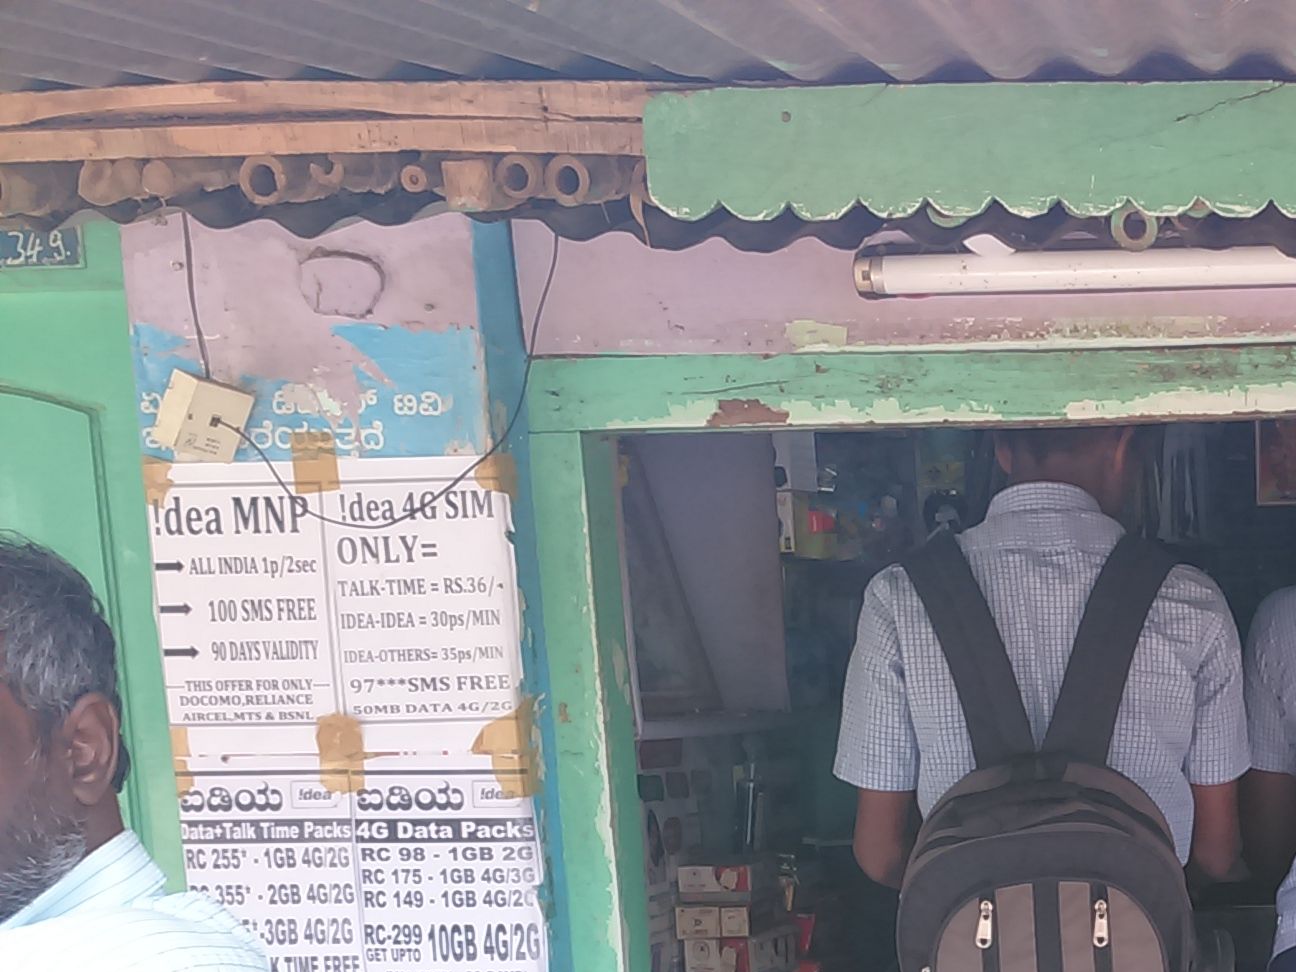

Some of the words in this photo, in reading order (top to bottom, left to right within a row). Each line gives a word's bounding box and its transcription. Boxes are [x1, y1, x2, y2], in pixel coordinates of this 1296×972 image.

[402, 491, 437, 520] 4G
[445, 490, 494, 519] SIM
[231, 495, 309, 535] MNP
[189, 558, 216, 575] ALL
[218, 557, 259, 575] INDIA
[262, 555, 317, 578] 1p/2sec
[338, 578, 426, 597] TALK-TIME
[208, 599, 237, 622] 100
[241, 599, 273, 622] SMS
[277, 599, 317, 621] FREE
[341, 612, 415, 630] IDEA-IDEA
[431, 609, 501, 631] 30ps/MIN
[212, 642, 226, 661] 90
[230, 641, 262, 661] DAYS
[262, 640, 319, 660] VALIDITY
[441, 646, 504, 664] 35ps/MIN
[185, 680, 213, 692] THIS
[215, 680, 253, 692] OFFER
[257, 680, 279, 691] FOR
[282, 679, 313, 691] ONLY
[456, 675, 511, 691] FREE
[180, 694, 313, 706] DOCOMO,RELIANCE
[353, 704, 401, 715] 50MB
[405, 703, 453, 714] DATA
[457, 701, 513, 713] 4G/2G
[266, 712, 275, 721] &
[279, 711, 314, 721] BSNL
[181, 822, 256, 840] Data+Talk
[260, 823, 299, 839] Time
[304, 821, 351, 838] Packs
[356, 821, 389, 839] 4G
[397, 821, 453, 839] Data
[461, 821, 534, 838] Packs
[187, 849, 206, 869] RC
[264, 848, 297, 869] 1GB
[302, 847, 350, 868] 4G/2G
[361, 847, 391, 861] RC
[399, 847, 426, 861] 98
[448, 847, 494, 861] 1GB
[502, 846, 533, 861] 2G
[362, 868, 385, 884] RC
[391, 868, 422, 884] 175
[440, 868, 476, 884] 1GB
[481, 867, 536, 884] 4G/3G
[267, 884, 301, 905] 2GB
[306, 884, 355, 904] 4G/2G
[364, 890, 387, 908] RC
[393, 890, 424, 907] 149
[441, 890, 477, 907] 1GB
[303, 917, 354, 945] 4G/2G
[364, 924, 422, 945] RC-299
[428, 924, 478, 962] 10GB
[483, 923, 541, 962] 4G/2G
[366, 948, 387, 962] GET
[391, 948, 421, 962] UPTO
